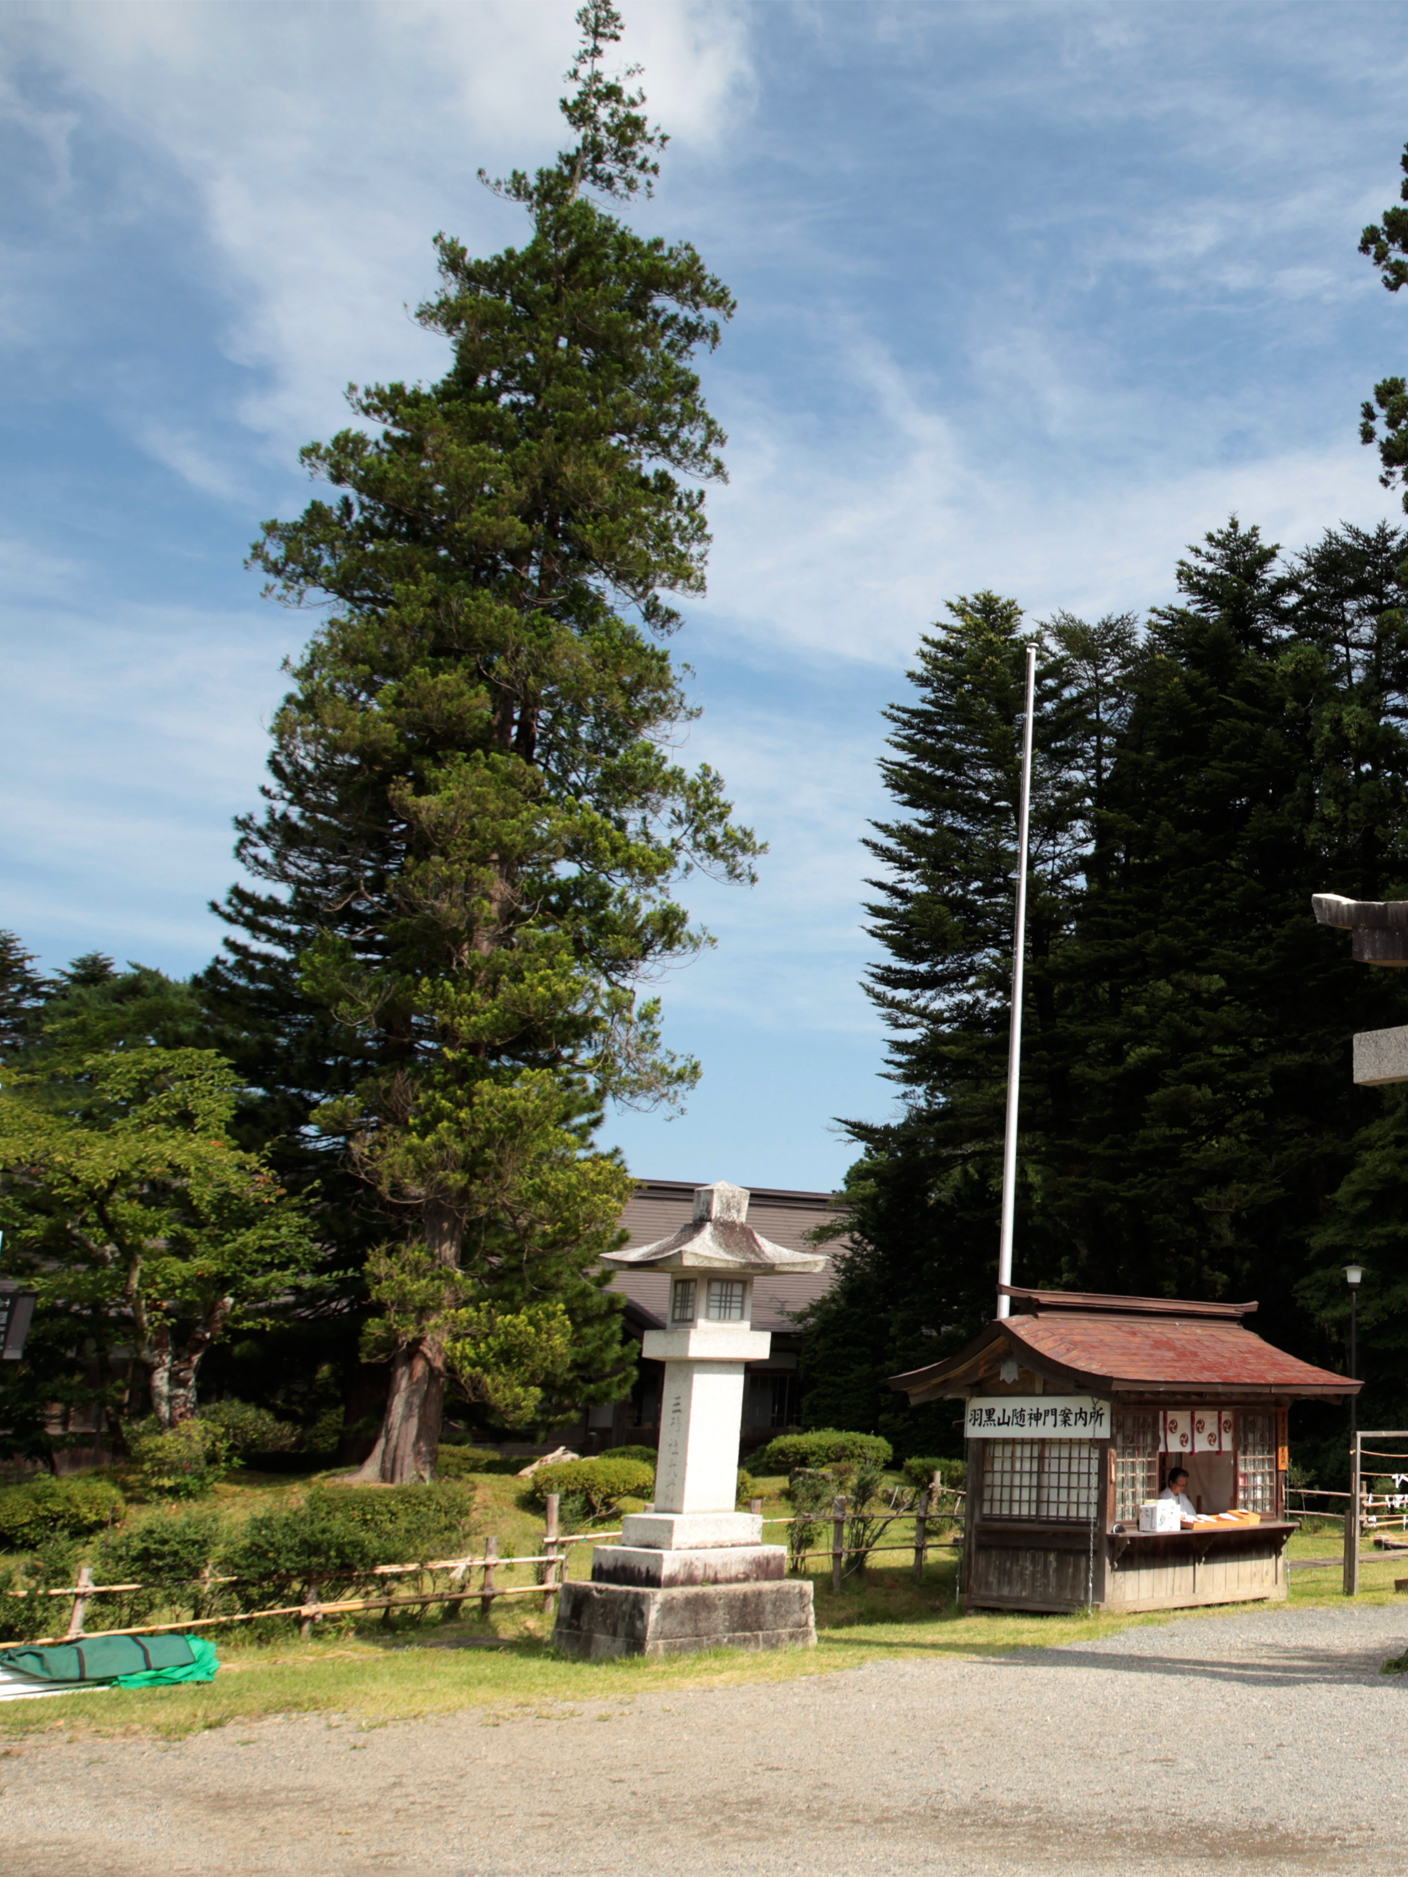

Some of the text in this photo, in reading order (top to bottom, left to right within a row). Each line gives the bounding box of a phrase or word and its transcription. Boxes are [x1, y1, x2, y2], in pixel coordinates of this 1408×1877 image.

[969, 1407, 1105, 1428] 羽黒山随神門案内所
